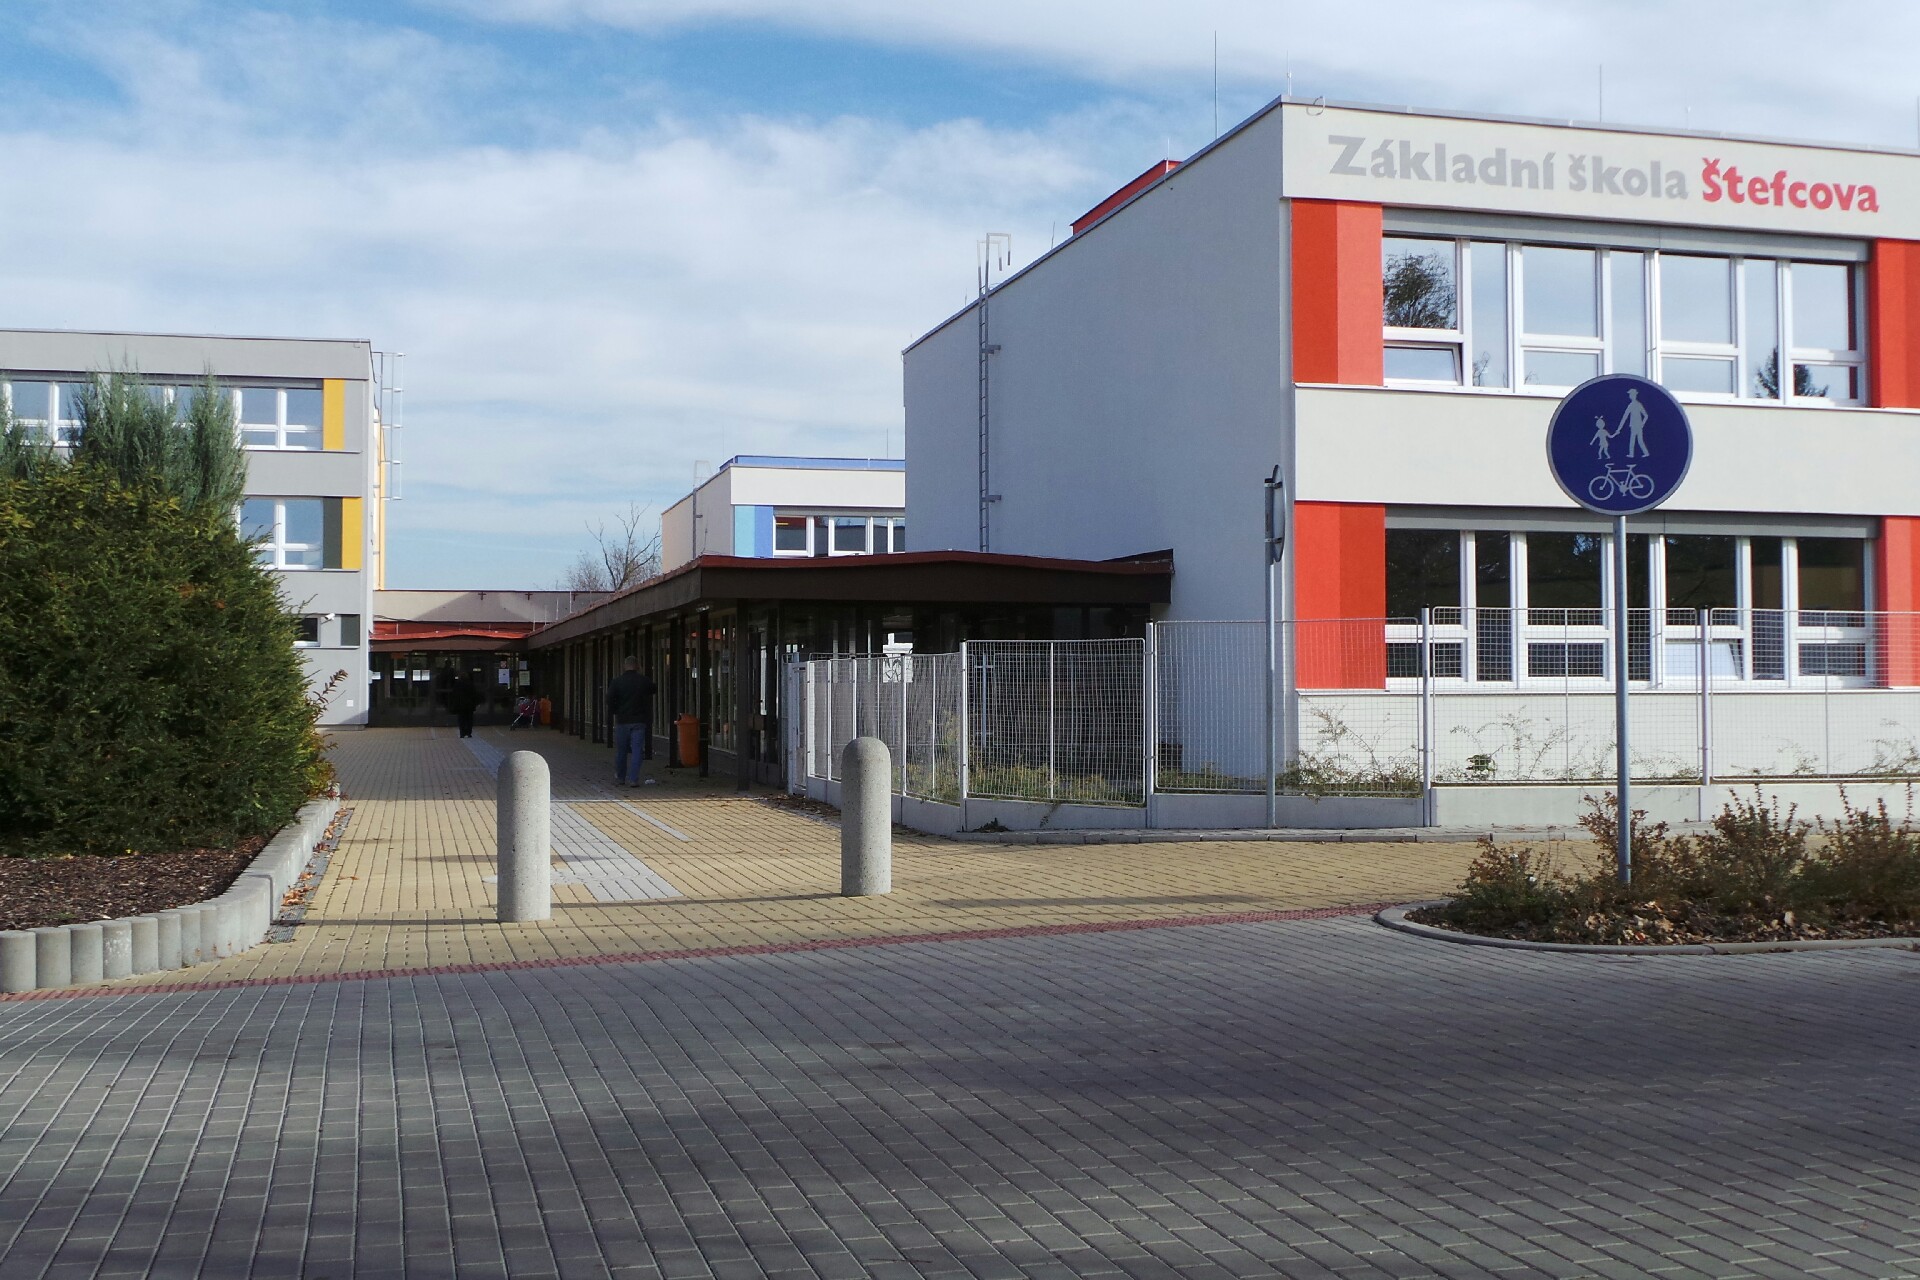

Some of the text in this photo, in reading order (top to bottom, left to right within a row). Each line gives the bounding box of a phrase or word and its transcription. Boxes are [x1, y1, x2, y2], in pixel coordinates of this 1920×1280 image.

[1328, 134, 1880, 213] Základní škola Štefcova
